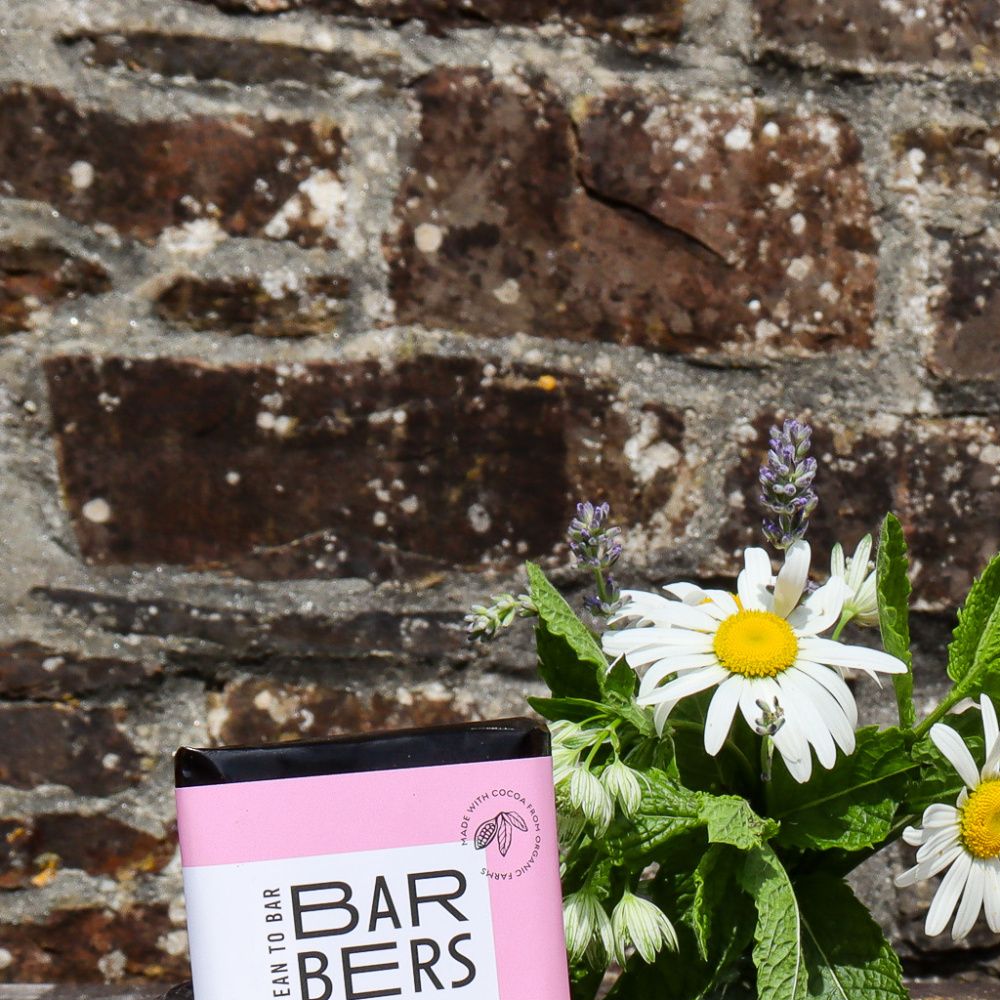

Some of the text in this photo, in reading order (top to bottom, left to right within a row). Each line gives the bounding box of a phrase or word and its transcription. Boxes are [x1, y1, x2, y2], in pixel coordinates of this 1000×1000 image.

[460, 788, 542, 880] MADE WITH COCOA FROM ORGANIC FARMS
[263, 887, 283, 923] BAR
[290, 869, 470, 940] BAR
[267, 932, 286, 954] TO
